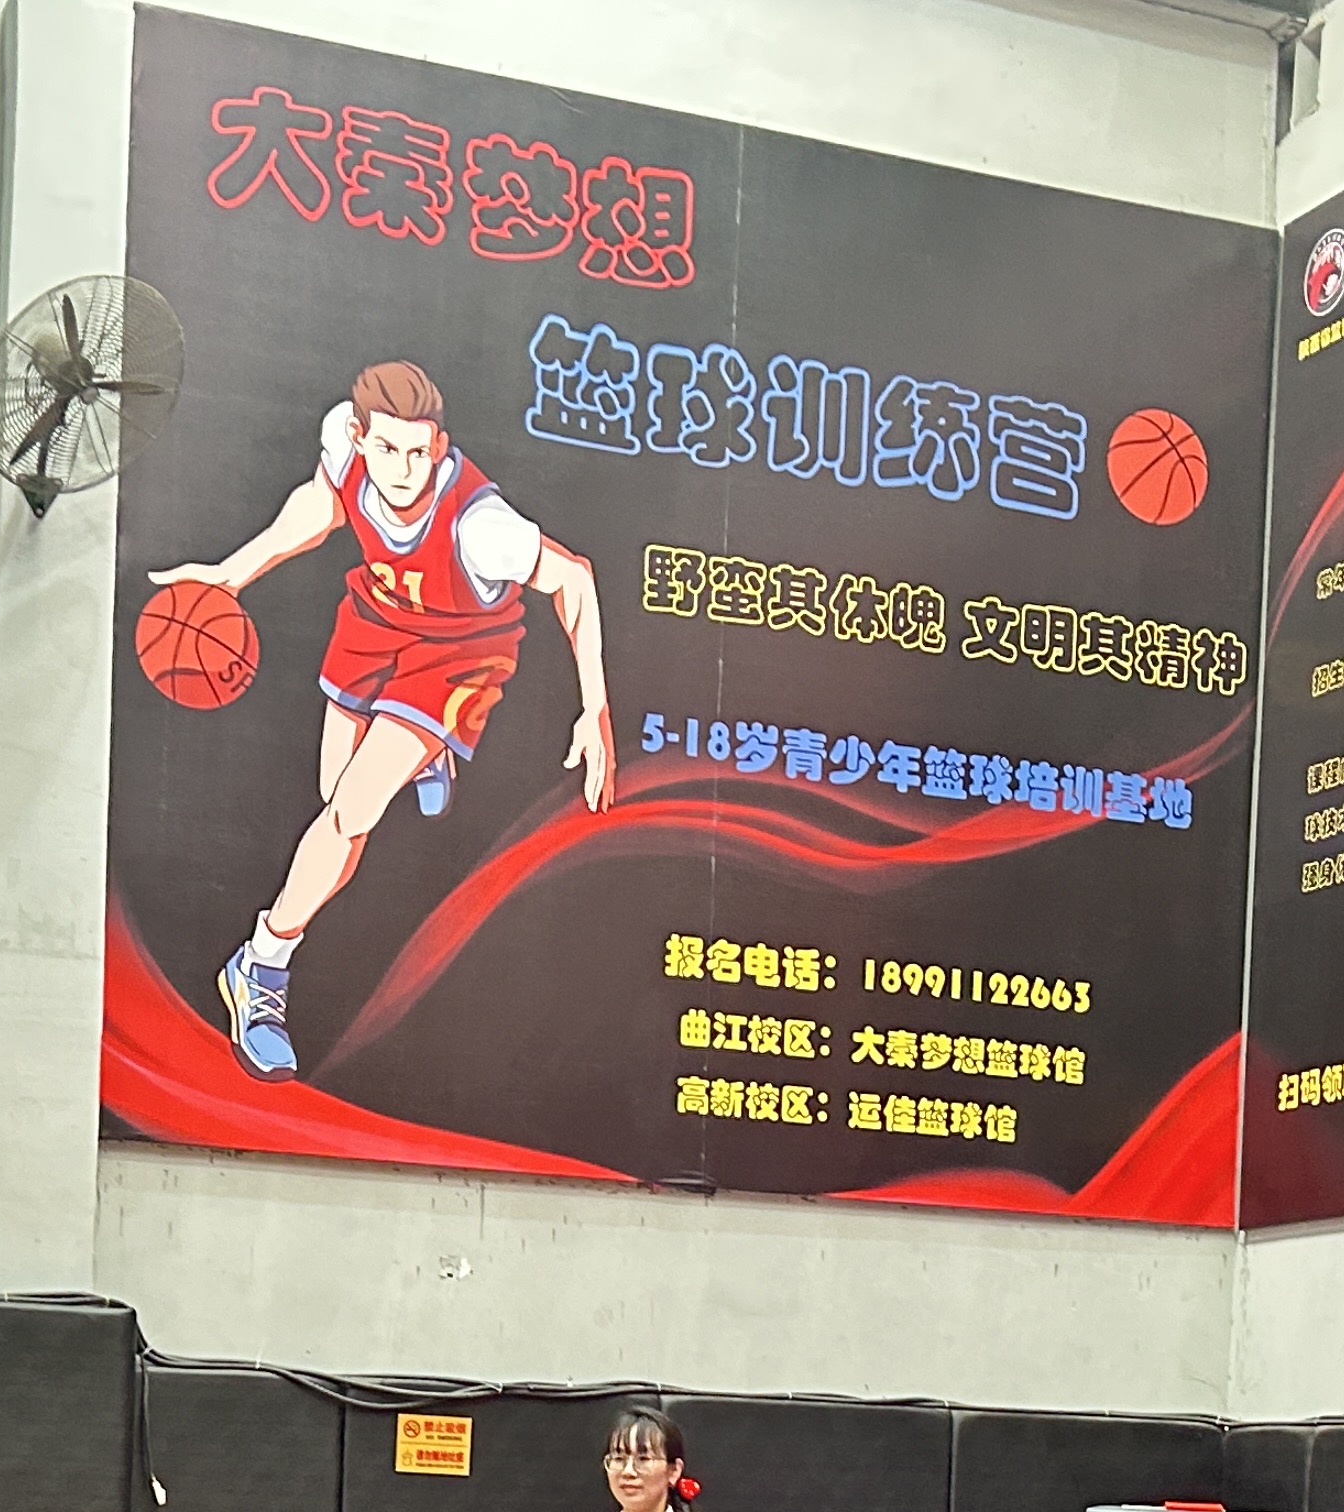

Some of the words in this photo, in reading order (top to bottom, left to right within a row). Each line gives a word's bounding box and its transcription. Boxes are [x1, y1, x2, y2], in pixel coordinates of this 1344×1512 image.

[207, 86, 694, 288] 大秦梦想
[525, 314, 1087, 520] 篮球训练营
[642, 545, 946, 654] 野蛮其体魄
[962, 597, 1248, 696] 文明其精神
[642, 713, 1194, 830] 5-18岁青少年篮球培训基地
